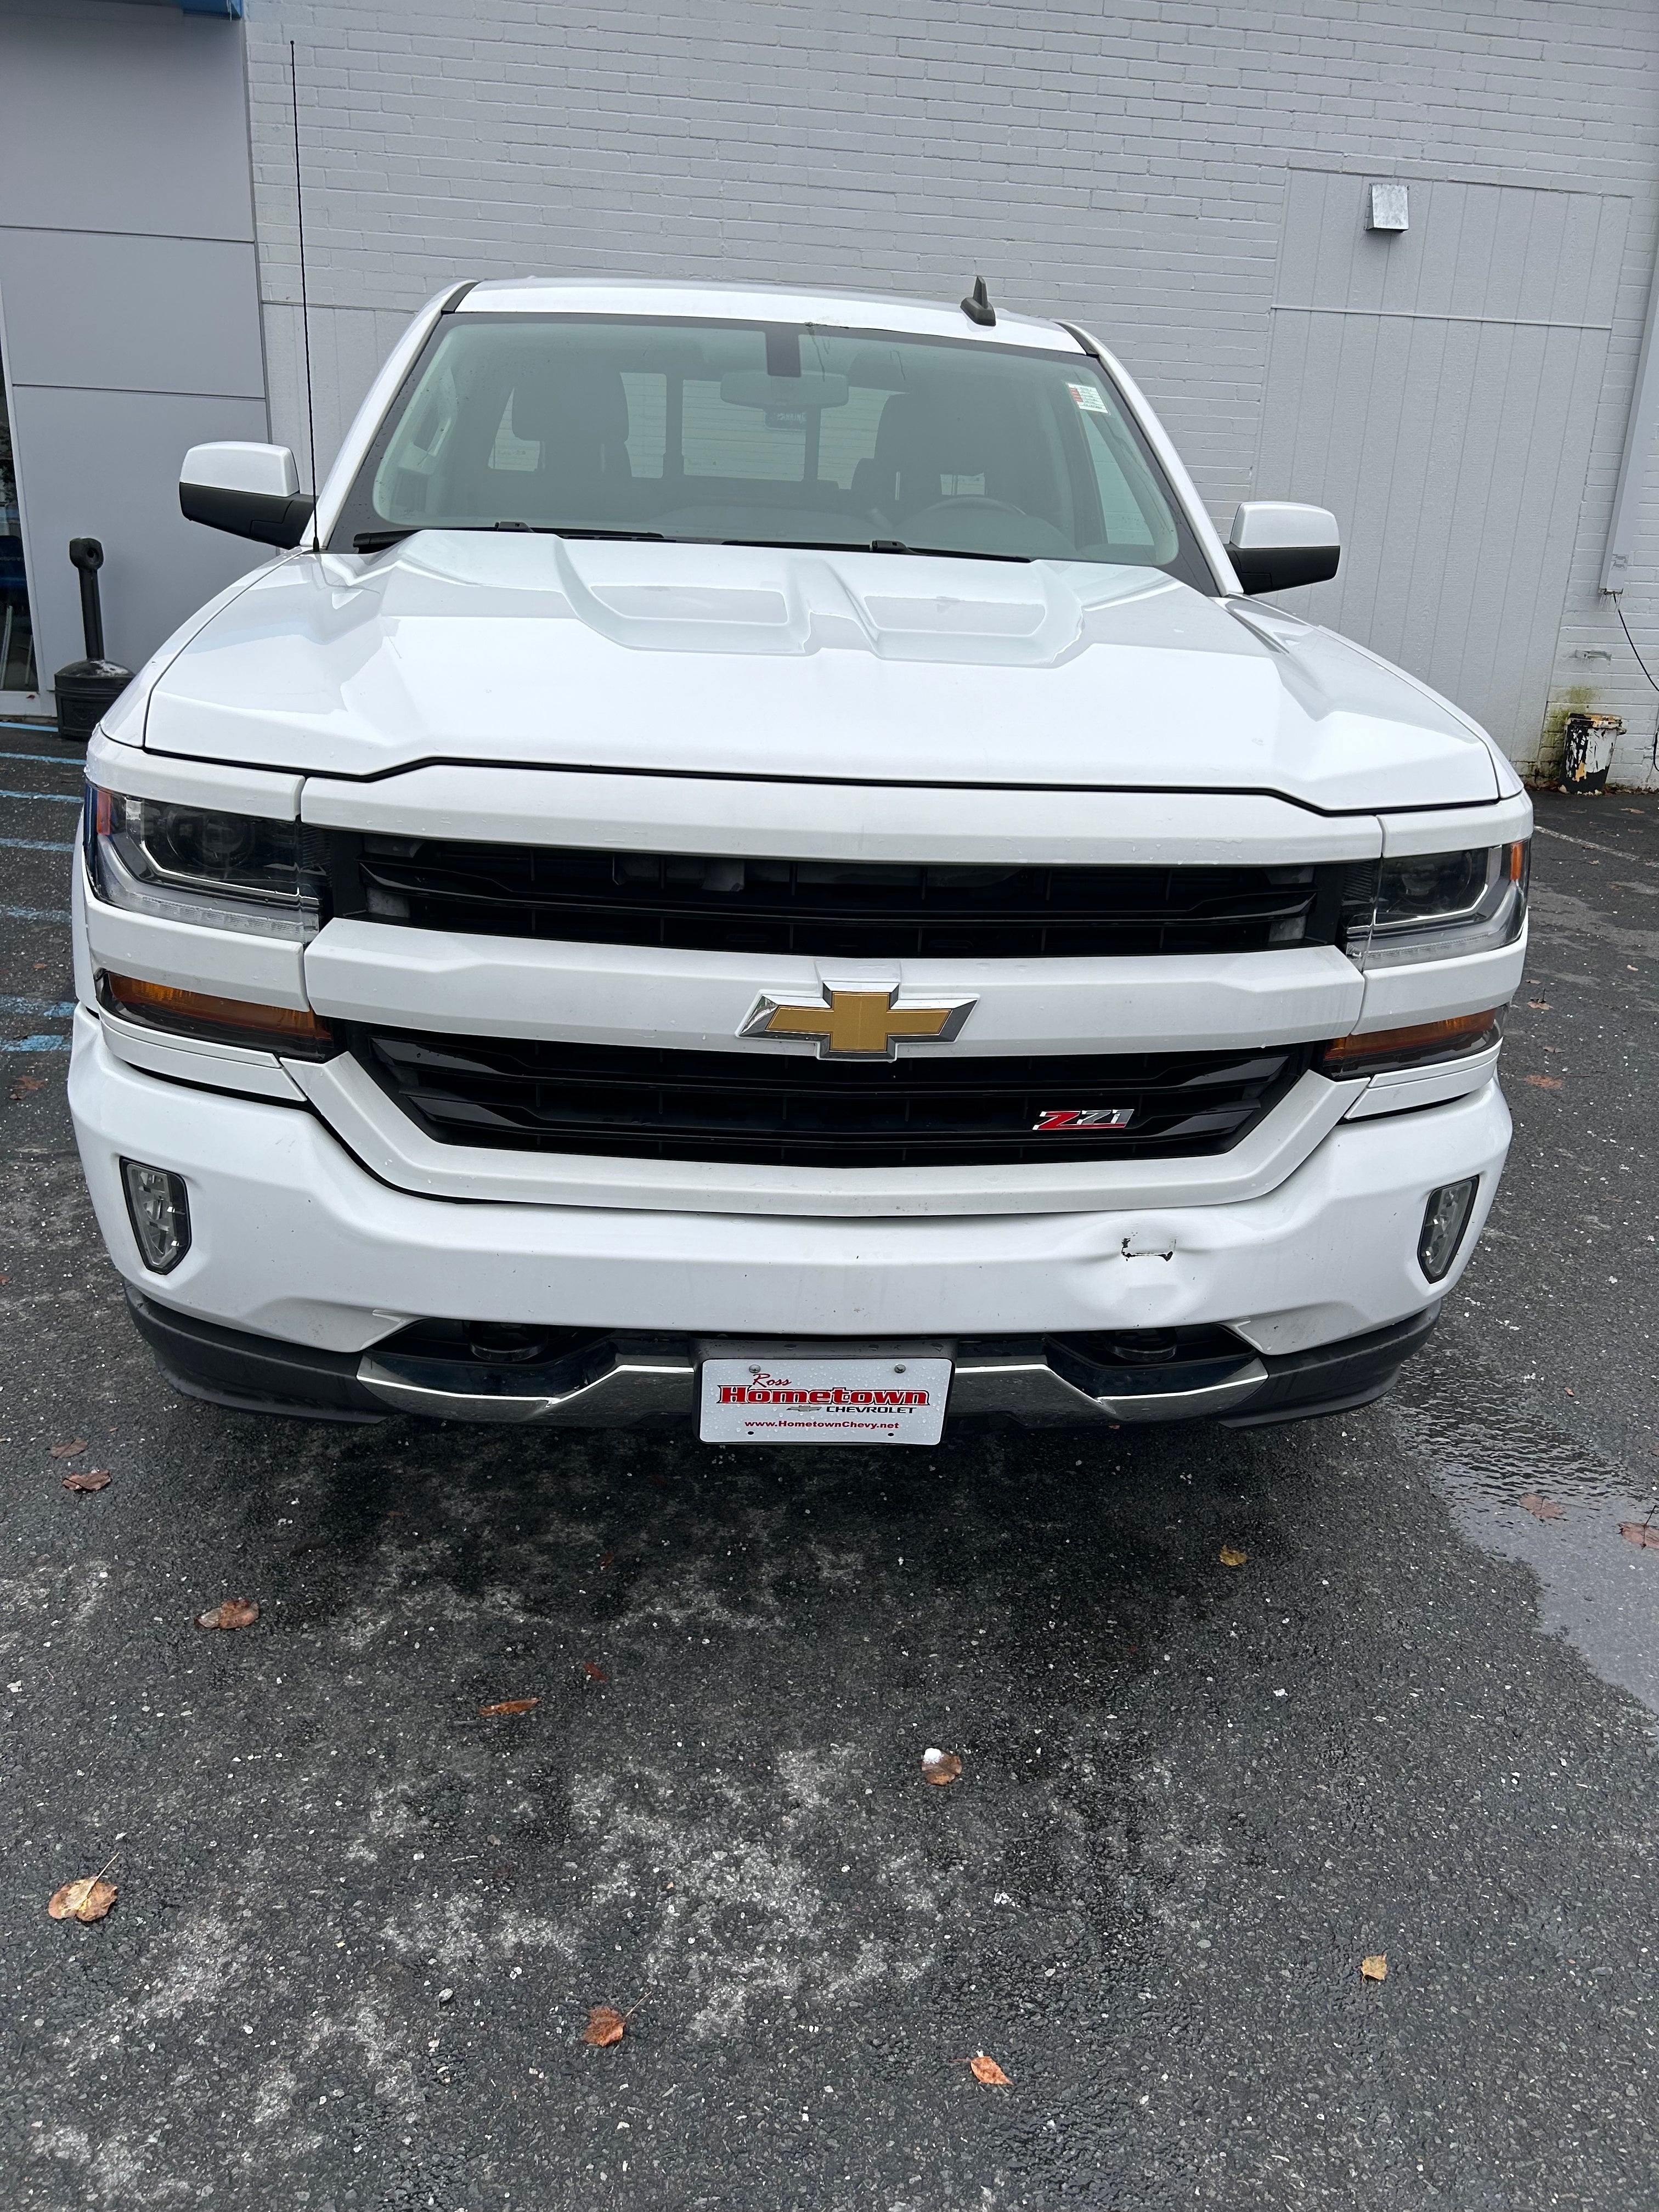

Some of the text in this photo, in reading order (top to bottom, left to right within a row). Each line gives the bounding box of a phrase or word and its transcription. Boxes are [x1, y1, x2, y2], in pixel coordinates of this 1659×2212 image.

[1032, 1109, 1135, 1130] Z71
[752, 1373, 792, 1388] Ross
[716, 1385, 930, 1406] Hometown
[744, 1420, 899, 1429] www.HometownChevy.net
